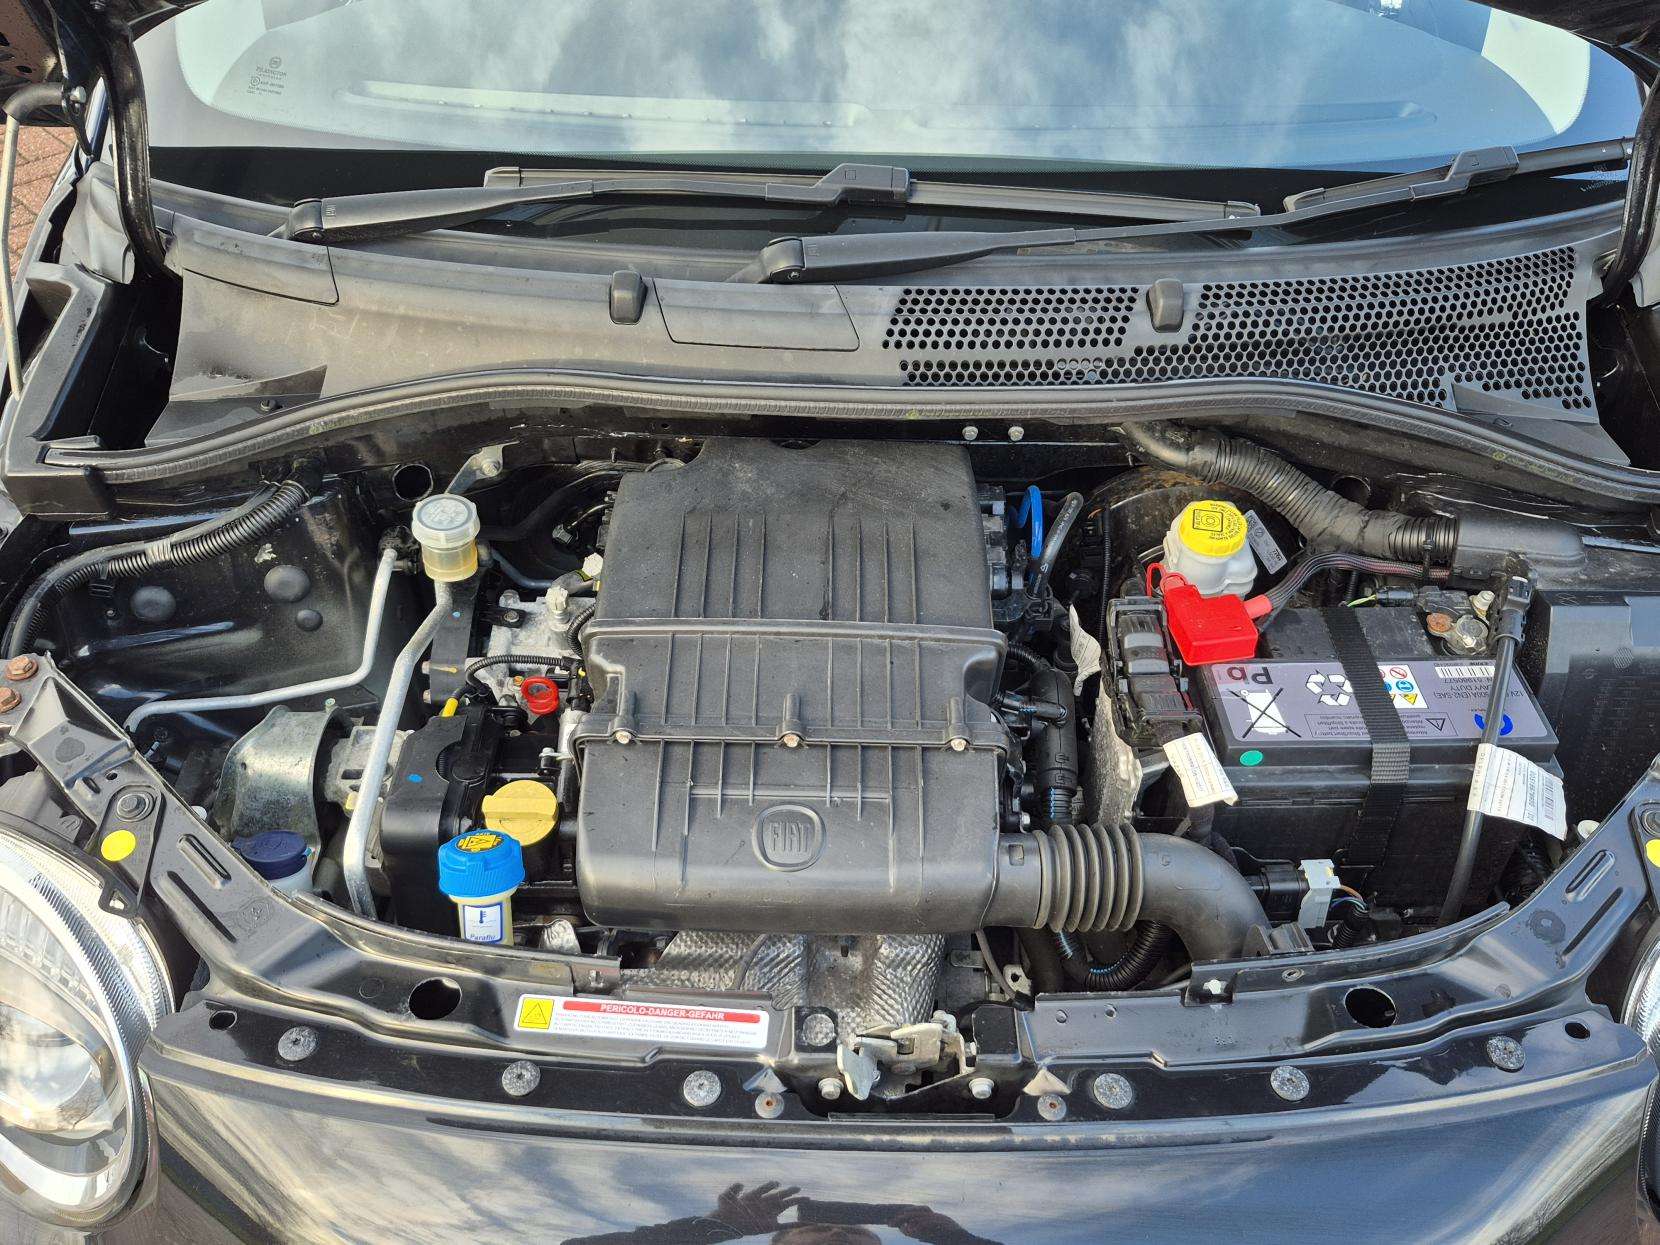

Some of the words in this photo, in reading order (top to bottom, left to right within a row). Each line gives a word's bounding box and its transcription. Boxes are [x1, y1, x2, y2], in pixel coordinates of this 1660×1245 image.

[1227, 666, 1273, 685] Pb
[769, 820, 811, 853] FIAT
[599, 1003, 726, 1021] PERICOLO-DANGER-GEFAHR
